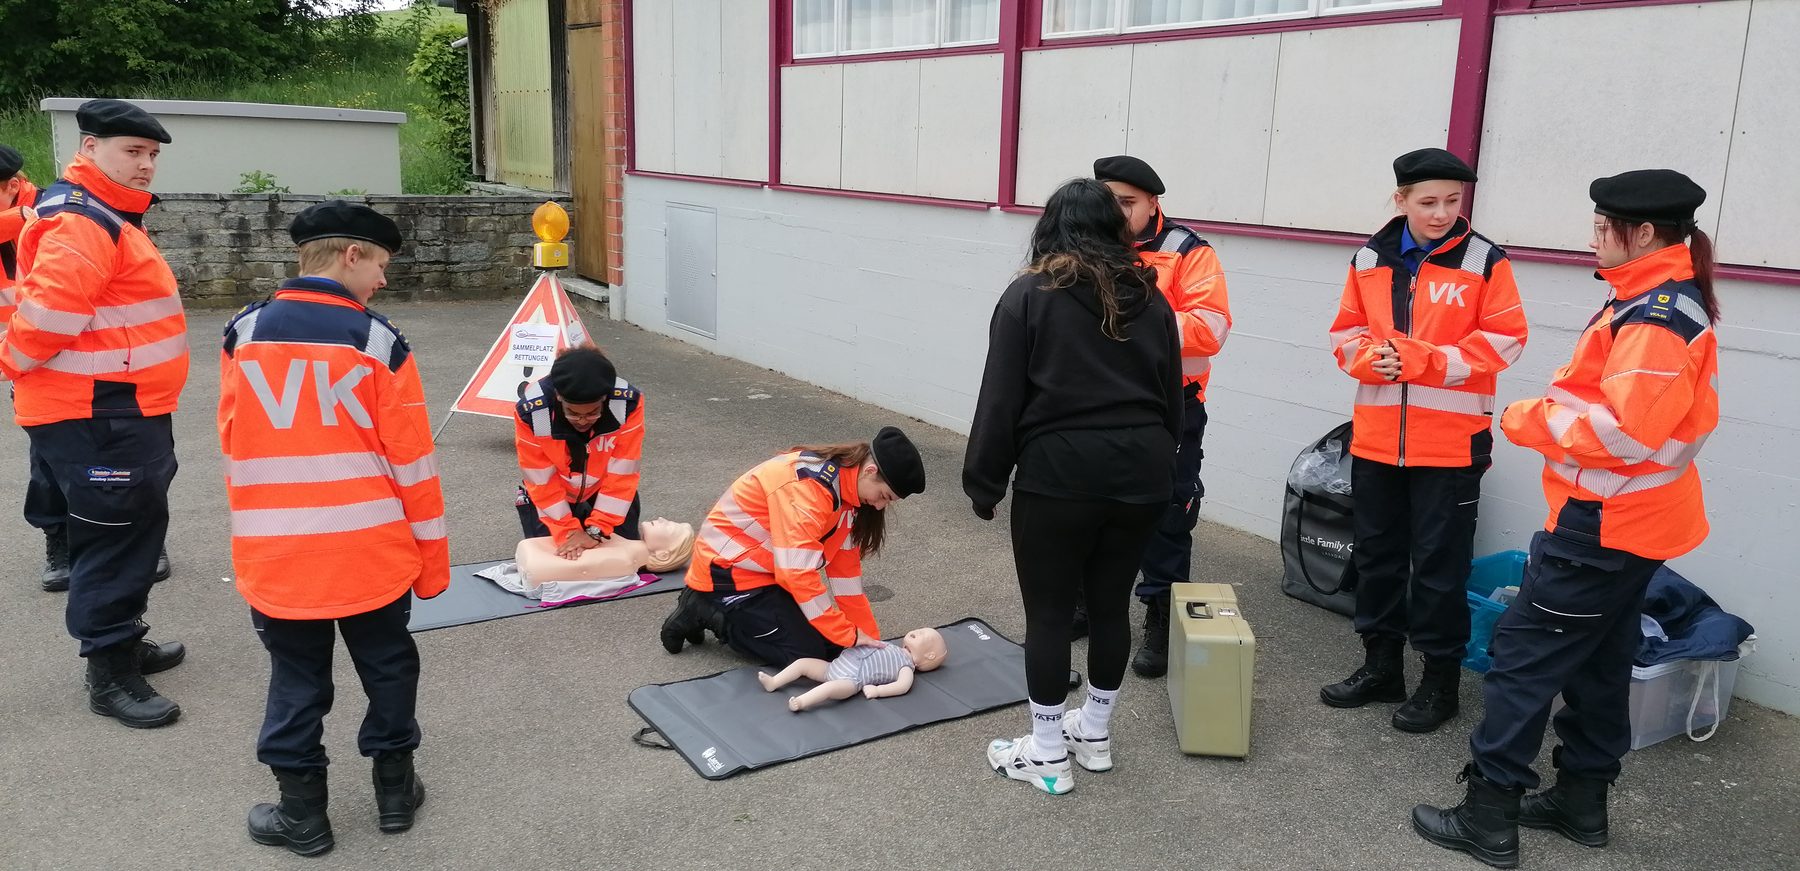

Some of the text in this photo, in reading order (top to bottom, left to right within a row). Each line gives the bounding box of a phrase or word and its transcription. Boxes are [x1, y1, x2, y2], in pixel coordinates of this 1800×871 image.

[1429, 281, 1469, 307] VK
[512, 344, 554, 352] SAMMELPLATZ
[240, 358, 374, 429] VK
[1317, 537, 1345, 552] Family
[1088, 690, 1110, 705] ANS
